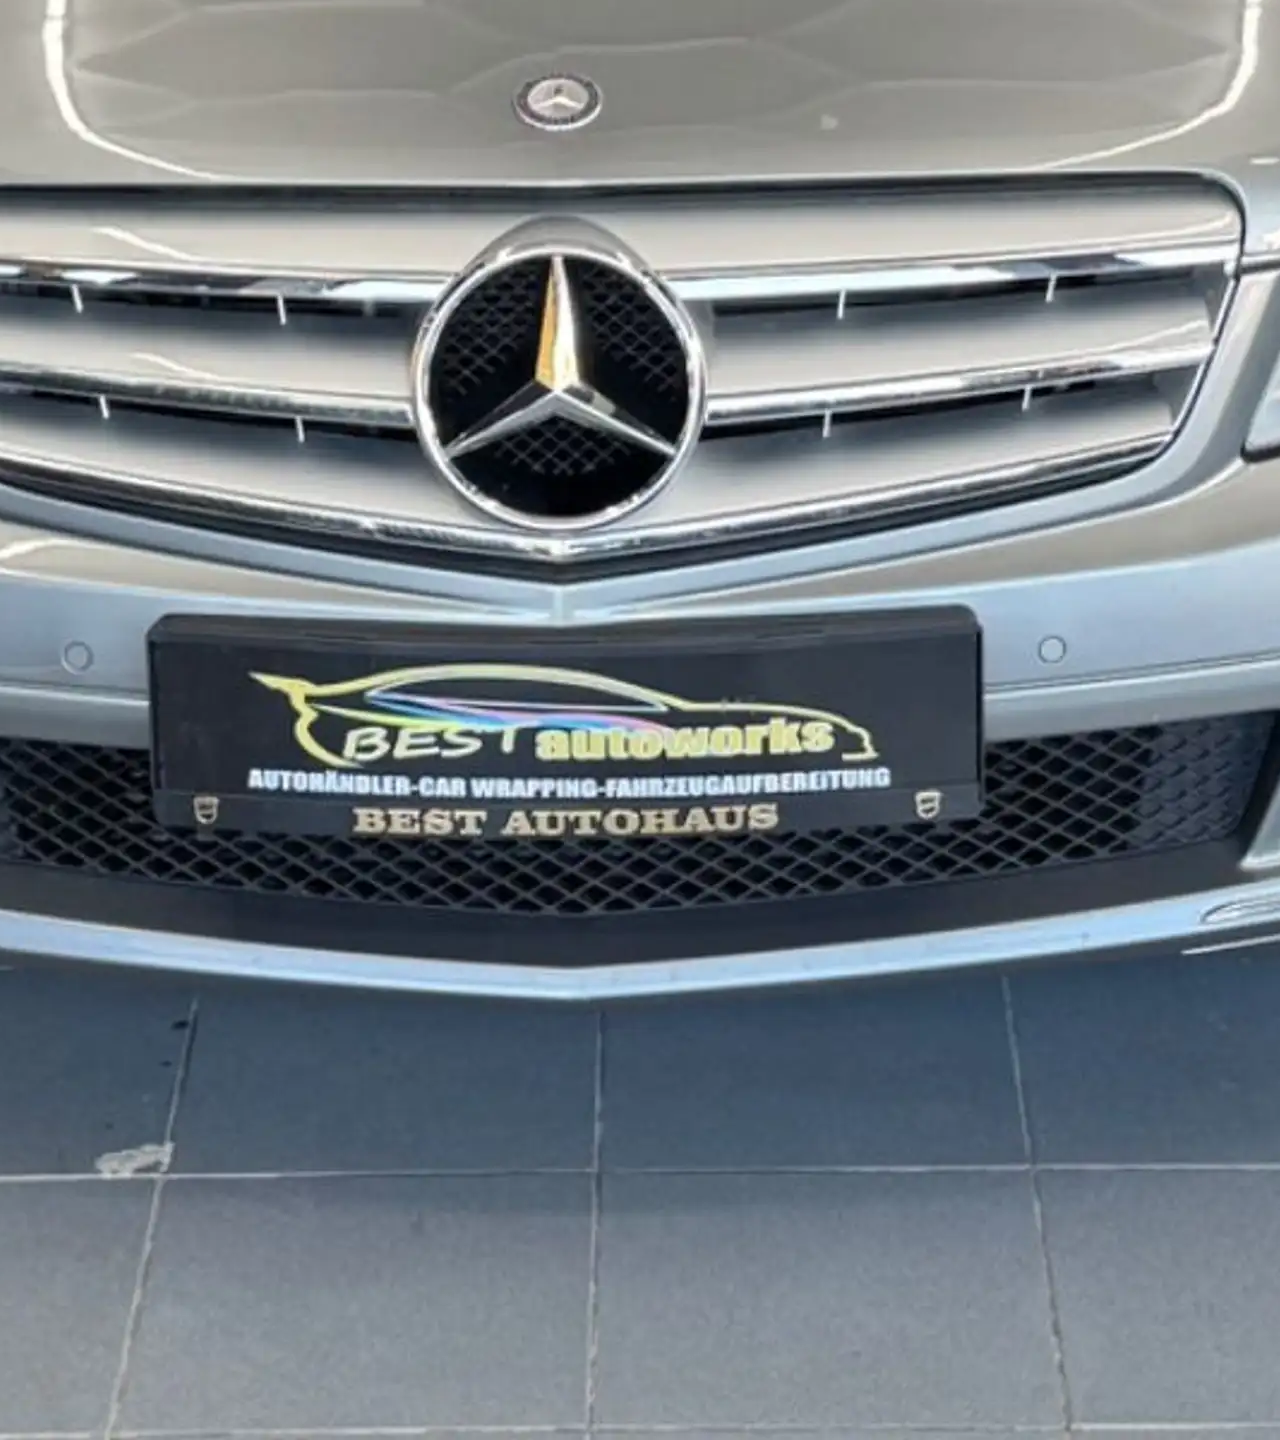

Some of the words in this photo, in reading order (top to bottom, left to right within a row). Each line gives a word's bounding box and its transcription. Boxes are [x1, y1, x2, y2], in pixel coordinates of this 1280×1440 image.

[342, 725, 518, 761] BEST
[536, 718, 835, 760] autoworks
[352, 807, 487, 836] BEST
[500, 803, 779, 837] AUTOHAUS
